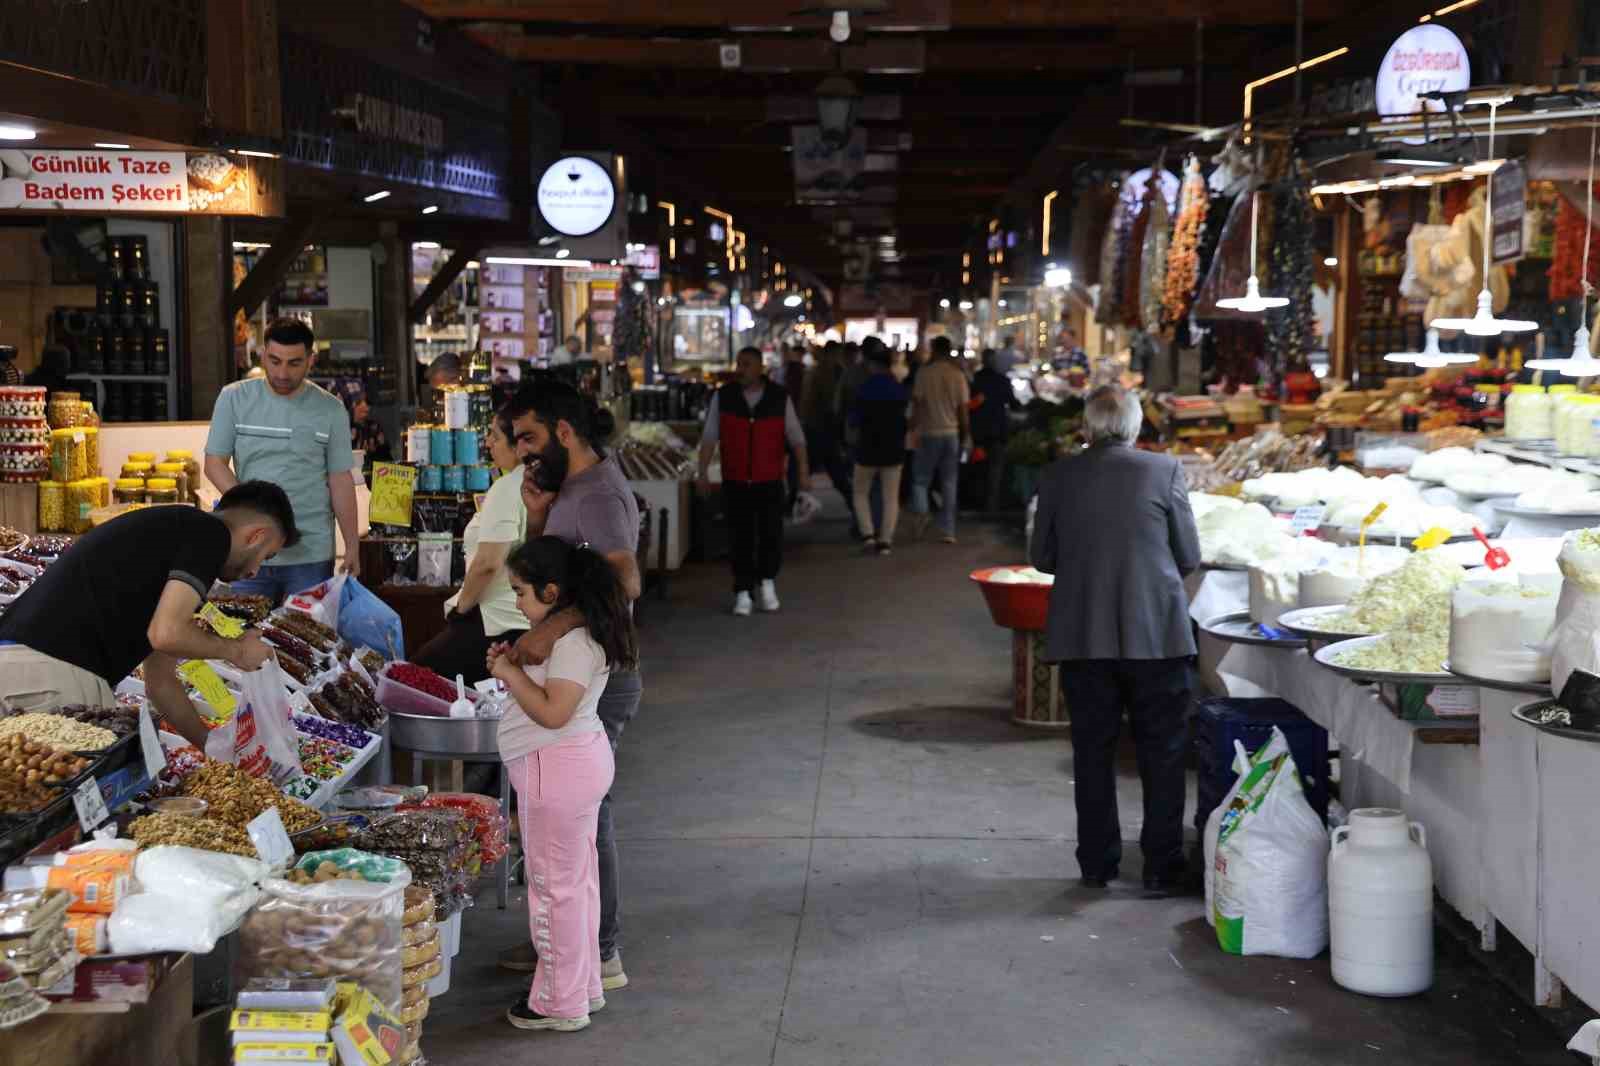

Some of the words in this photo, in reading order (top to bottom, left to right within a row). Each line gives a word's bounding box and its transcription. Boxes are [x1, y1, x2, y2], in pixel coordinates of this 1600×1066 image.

[31, 155, 112, 174] Günlük
[118, 156, 172, 174] Taze
[24, 182, 104, 200] Badem
[111, 183, 182, 204] Şekeri
